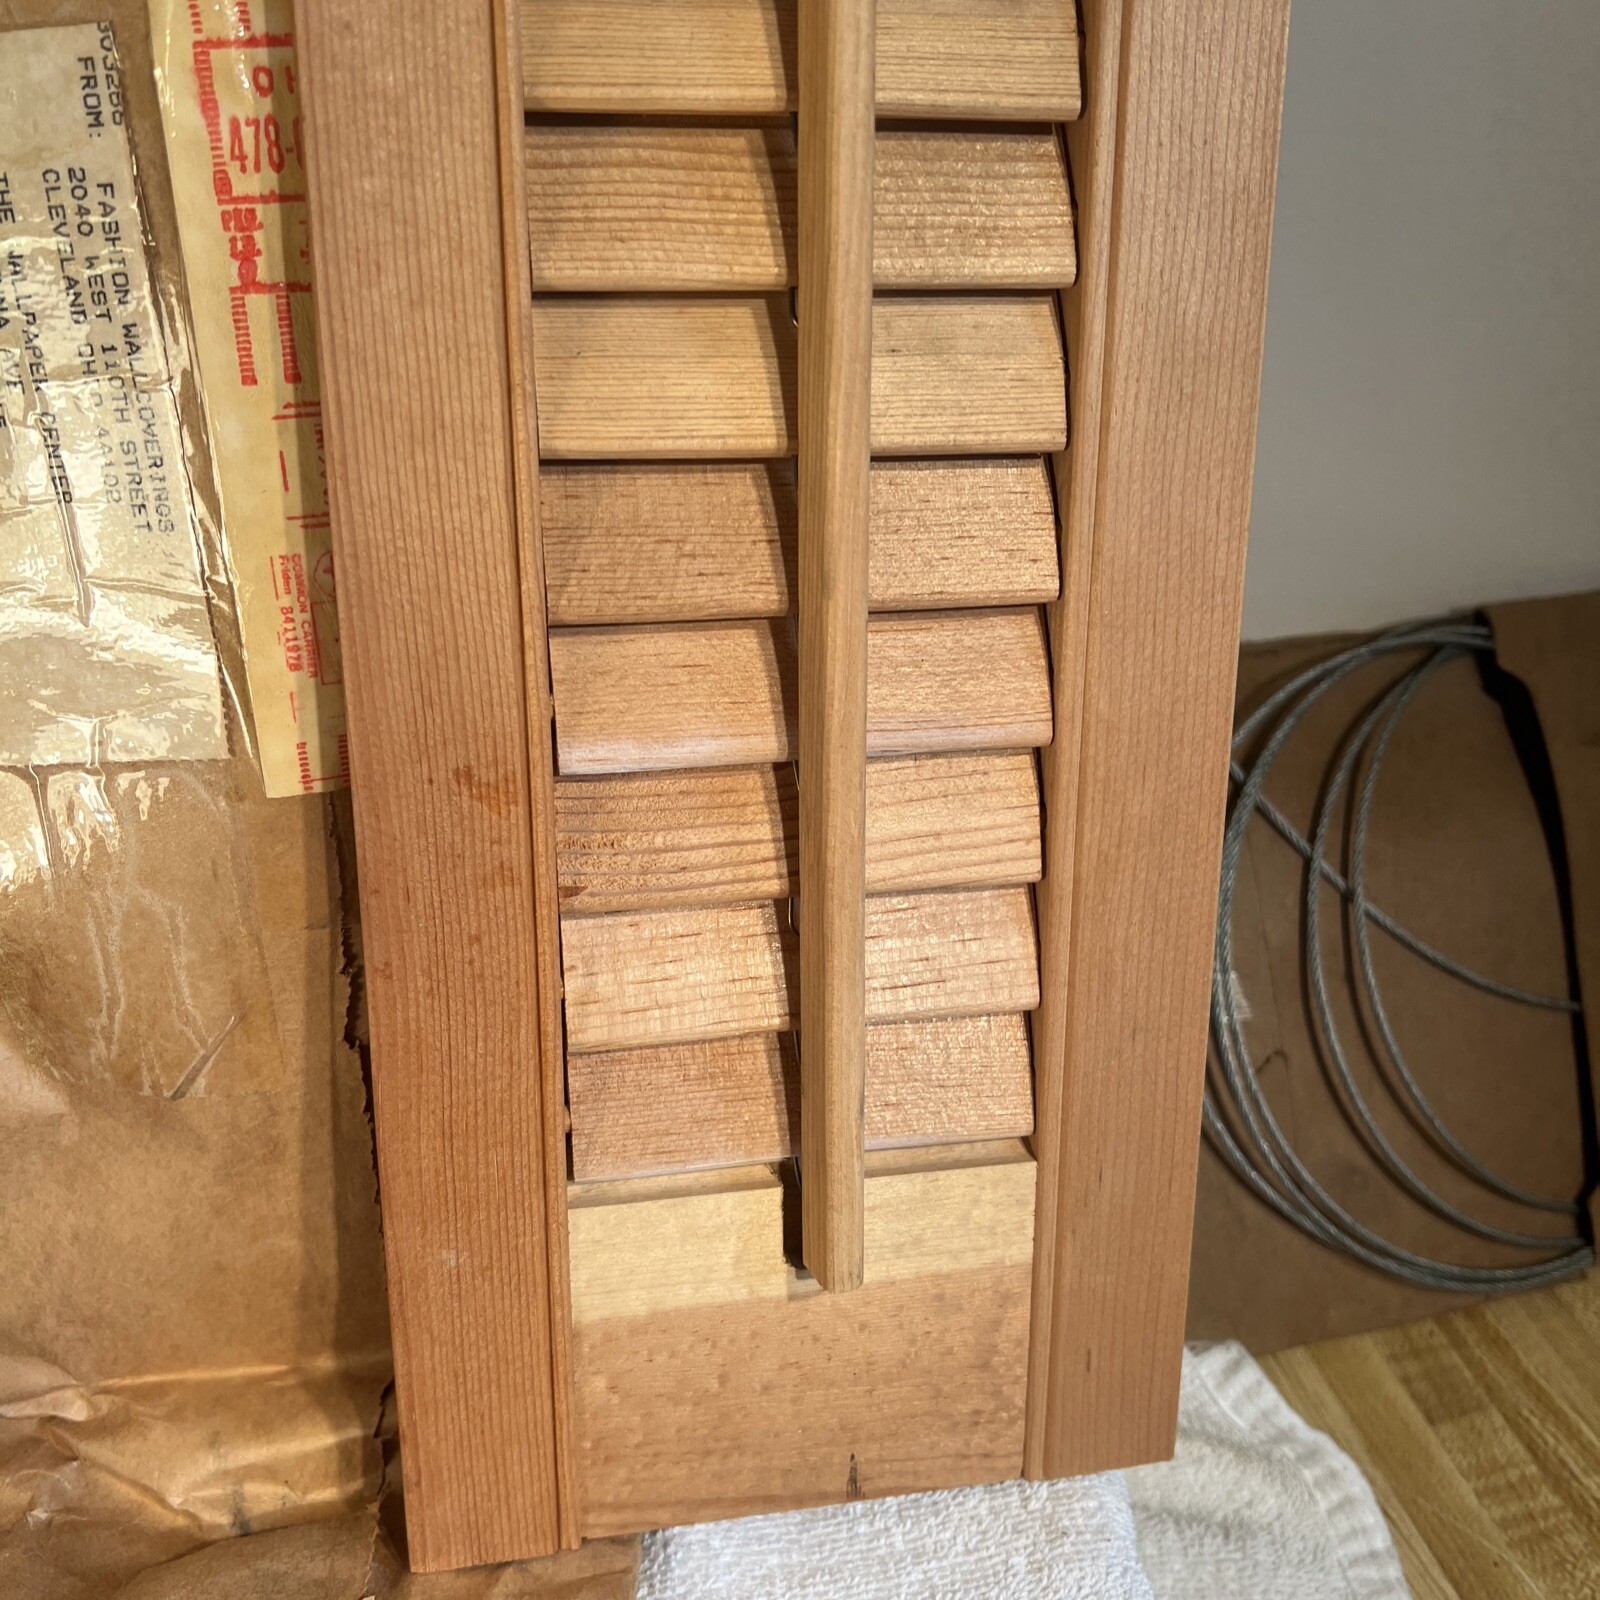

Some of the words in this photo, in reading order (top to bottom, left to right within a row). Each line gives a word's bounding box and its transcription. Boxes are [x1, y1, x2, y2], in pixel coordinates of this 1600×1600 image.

[77, 57, 105, 138] FROM:
[0, 171, 16, 224] THE
[42, 168, 88, 325] CLEVELAND
[68, 167, 94, 237] 2040
[85, 256, 112, 323] WEST
[101, 344, 131, 424] 110TH
[120, 440, 152, 532] STREET
[97, 182, 131, 306] FASHION
[122, 322, 175, 533] WALLCOVERINGS
[292, 553, 308, 614] COMMON
[301, 620, 319, 679] CARRIER
